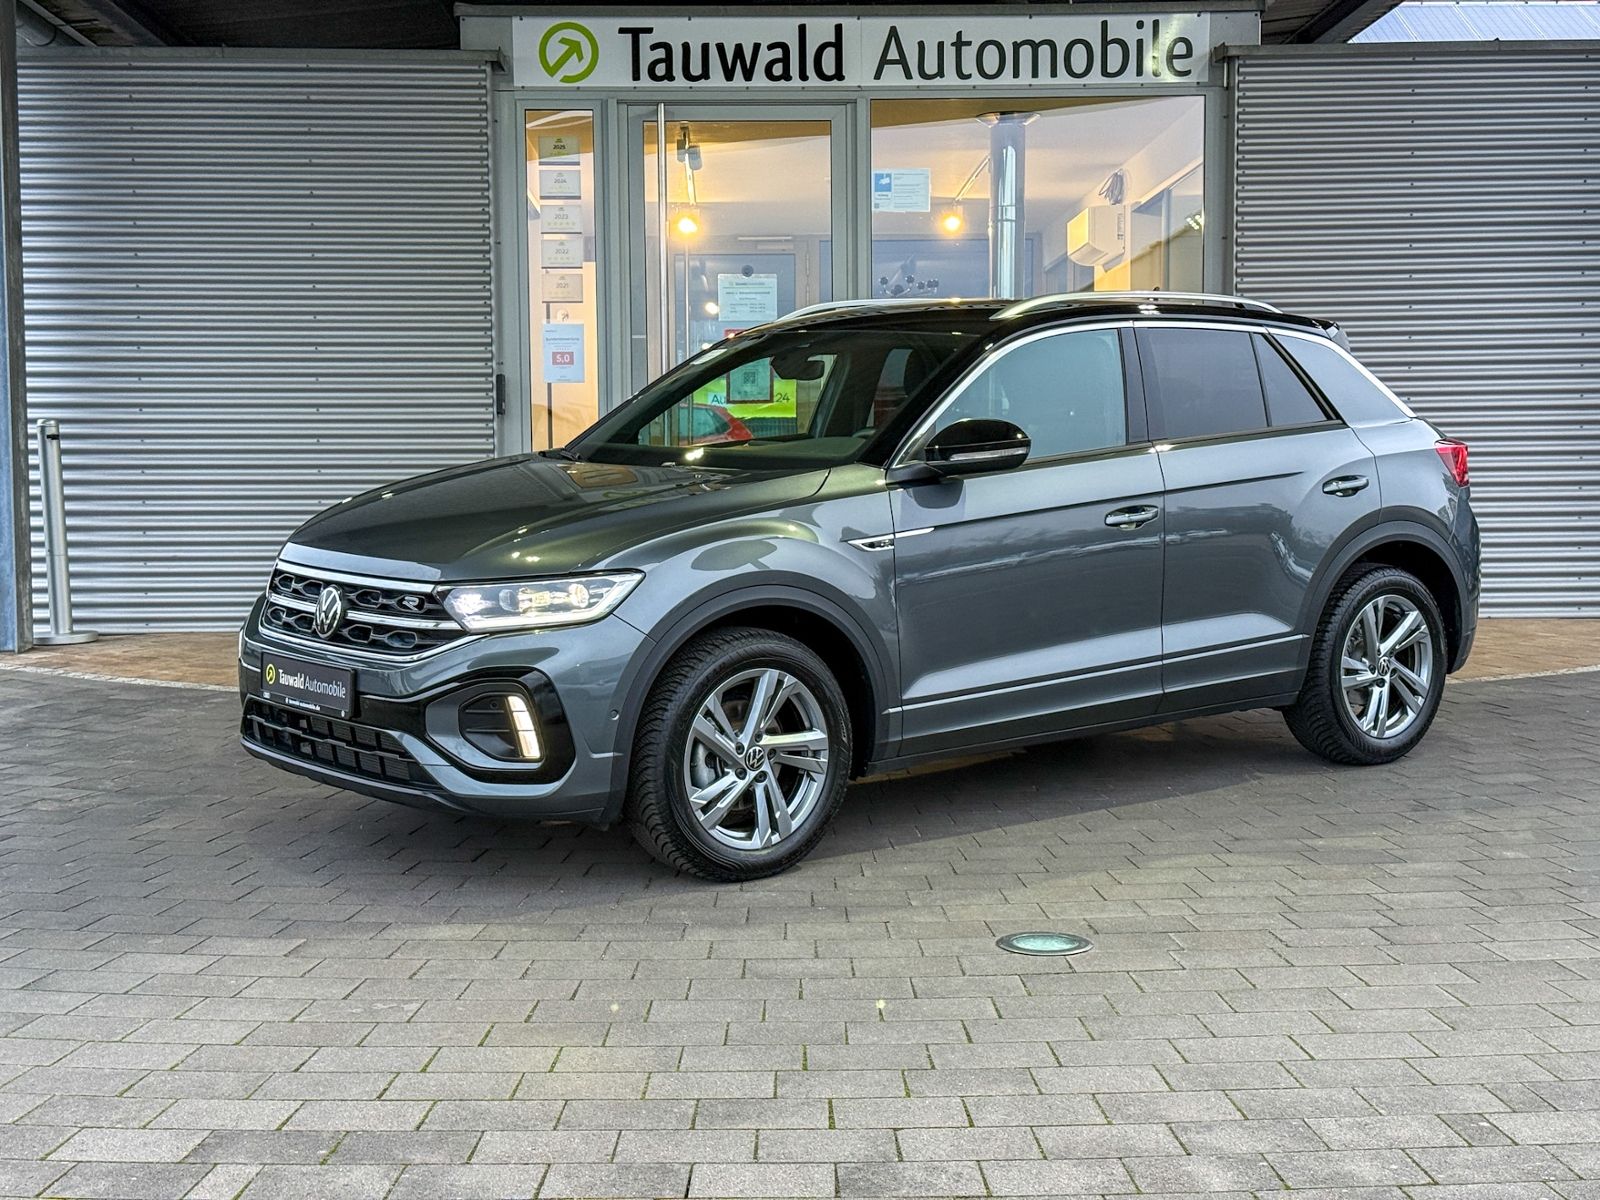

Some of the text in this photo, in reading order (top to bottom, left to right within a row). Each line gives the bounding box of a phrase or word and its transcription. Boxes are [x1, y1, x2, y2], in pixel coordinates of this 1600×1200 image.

[618, 19, 1193, 82] Tauwald Automobile
[278, 669, 346, 698] Tauwald Automobile
